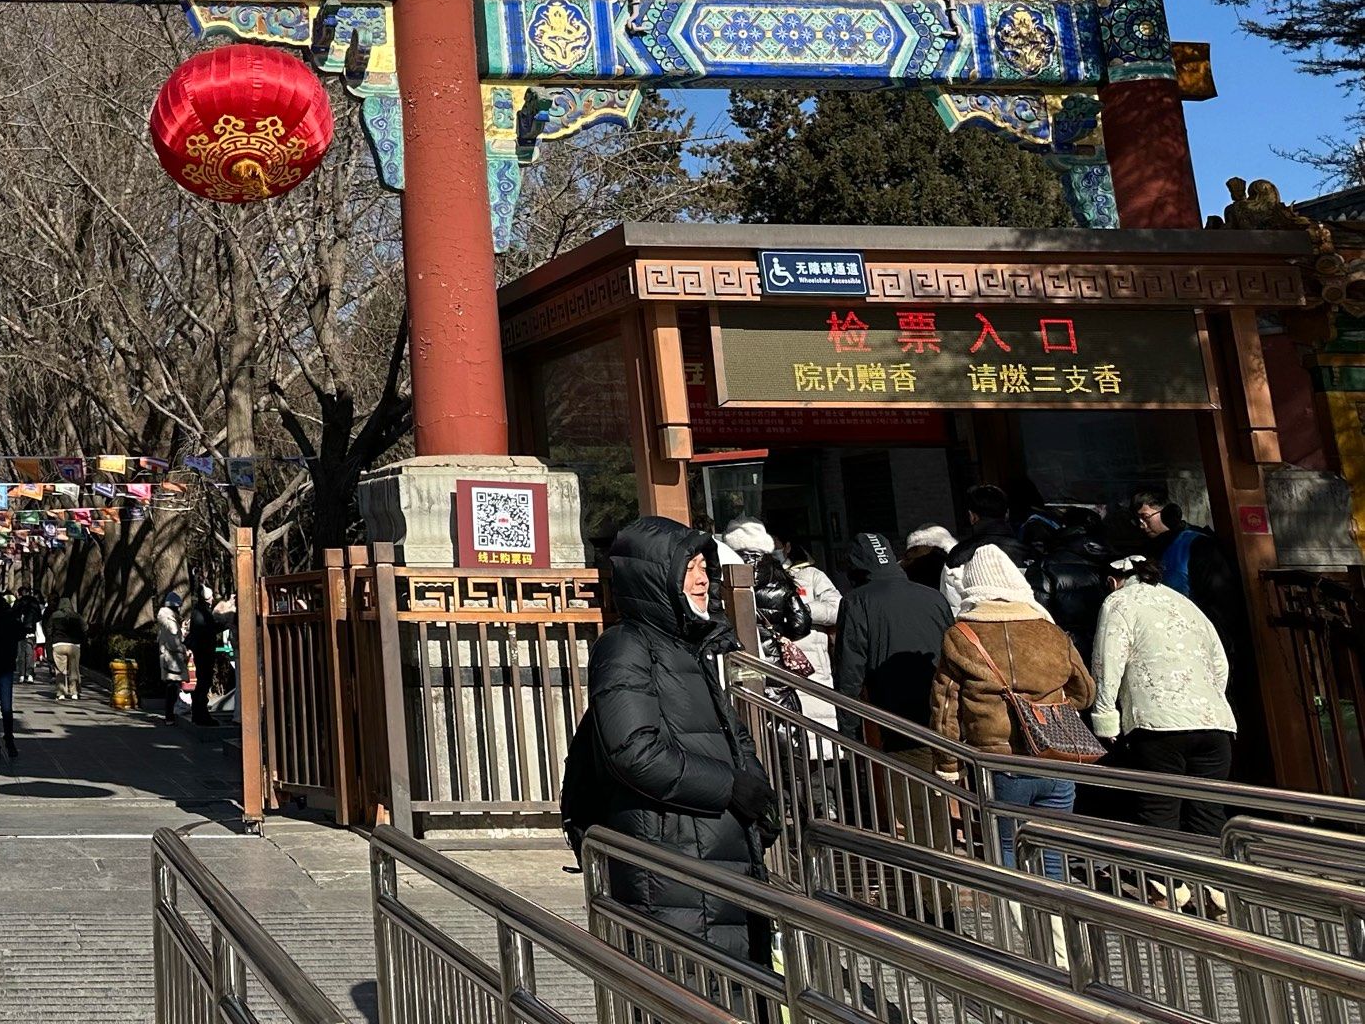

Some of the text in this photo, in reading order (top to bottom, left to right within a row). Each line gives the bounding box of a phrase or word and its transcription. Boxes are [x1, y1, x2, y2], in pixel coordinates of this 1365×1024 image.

[796, 262, 859, 275] 无障碍通道
[826, 311, 1079, 354] 检票入口
[794, 362, 1123, 395] 院内赠香 请燃三支香
[478, 551, 533, 566] 线上购票码
